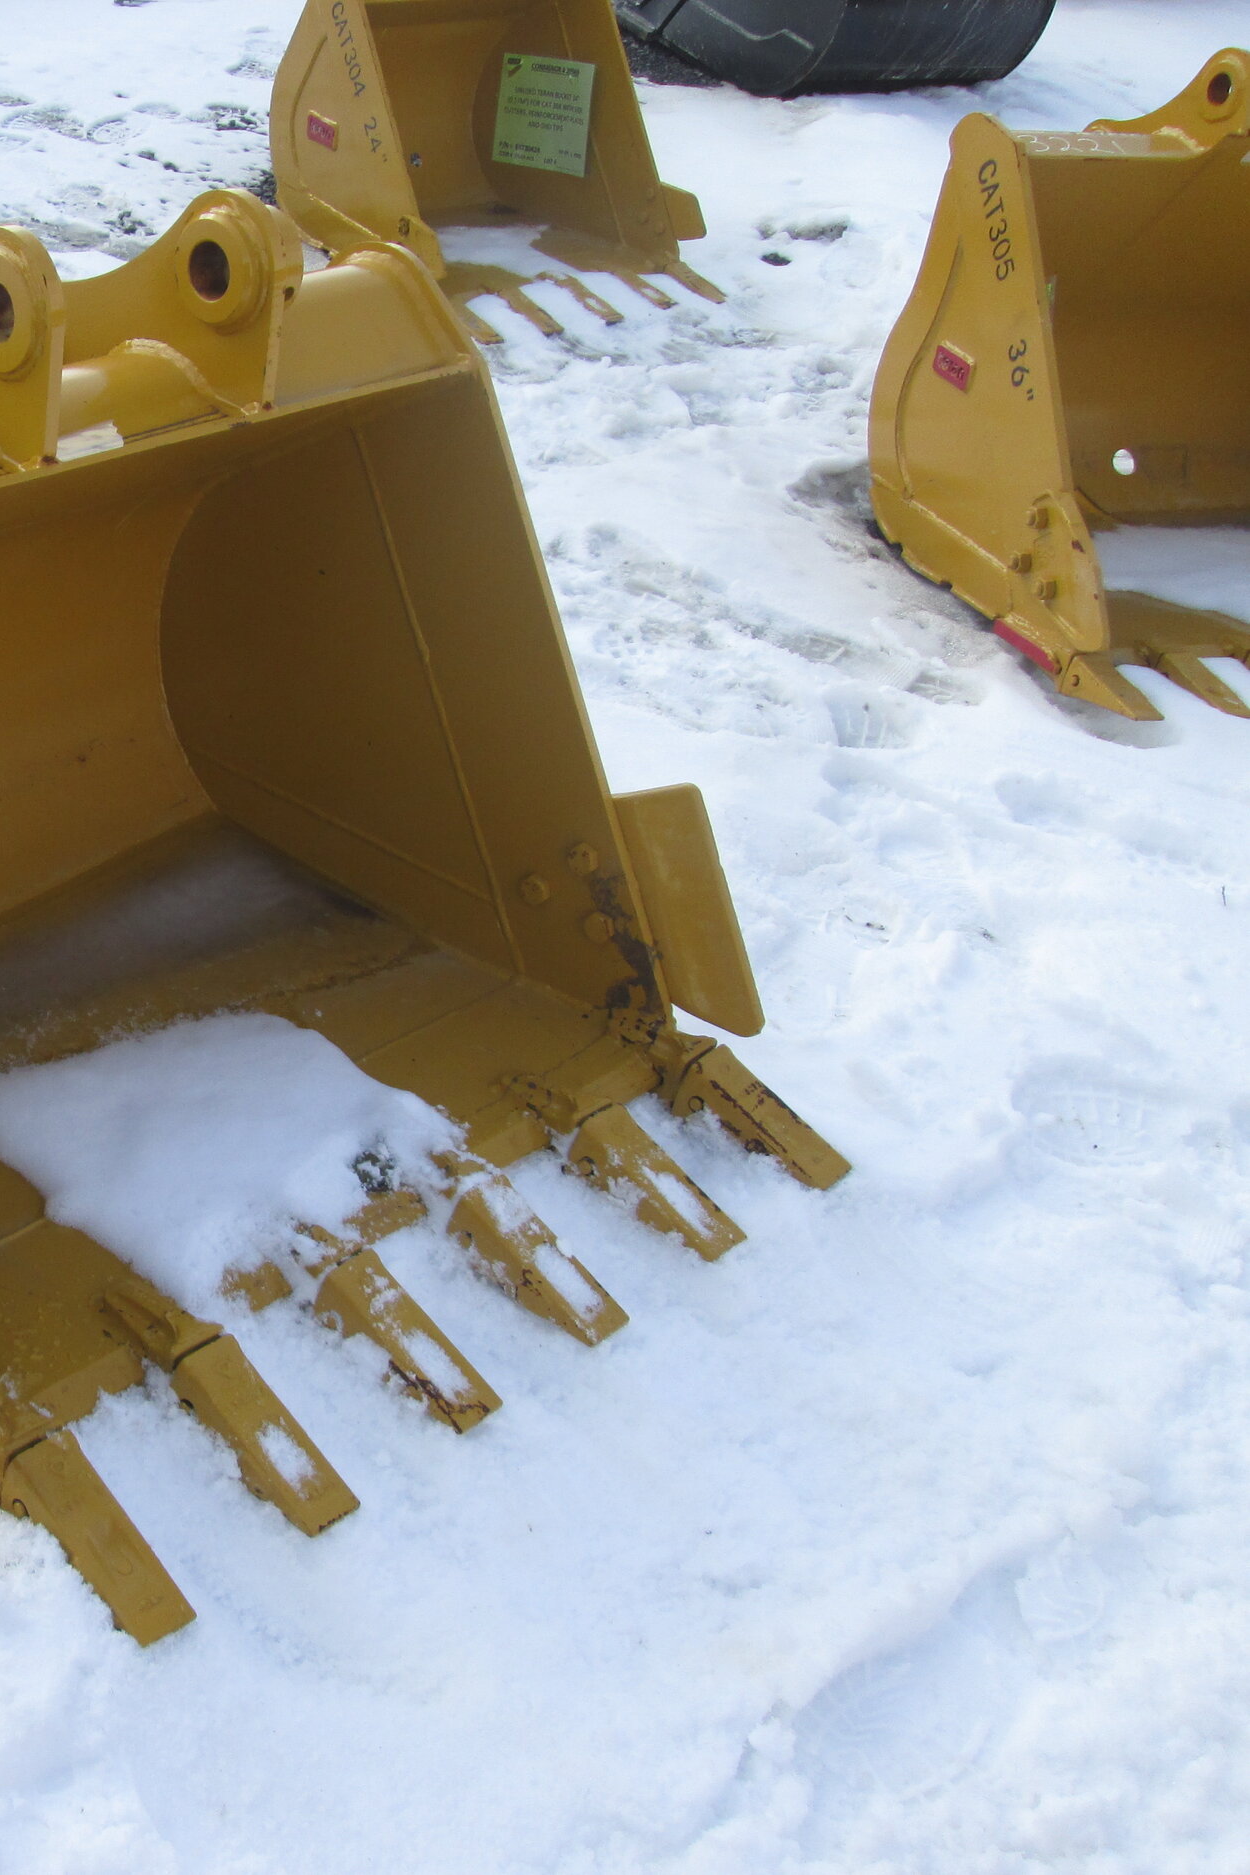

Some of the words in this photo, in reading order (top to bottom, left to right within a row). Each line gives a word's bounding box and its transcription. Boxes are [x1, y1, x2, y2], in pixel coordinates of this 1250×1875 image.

[332, 2, 366, 97] CAT304
[363, 116, 388, 163] 24"
[1017, 134, 1127, 155] 3221
[978, 158, 1015, 281] CAT305
[1007, 339, 1035, 402] 36"
